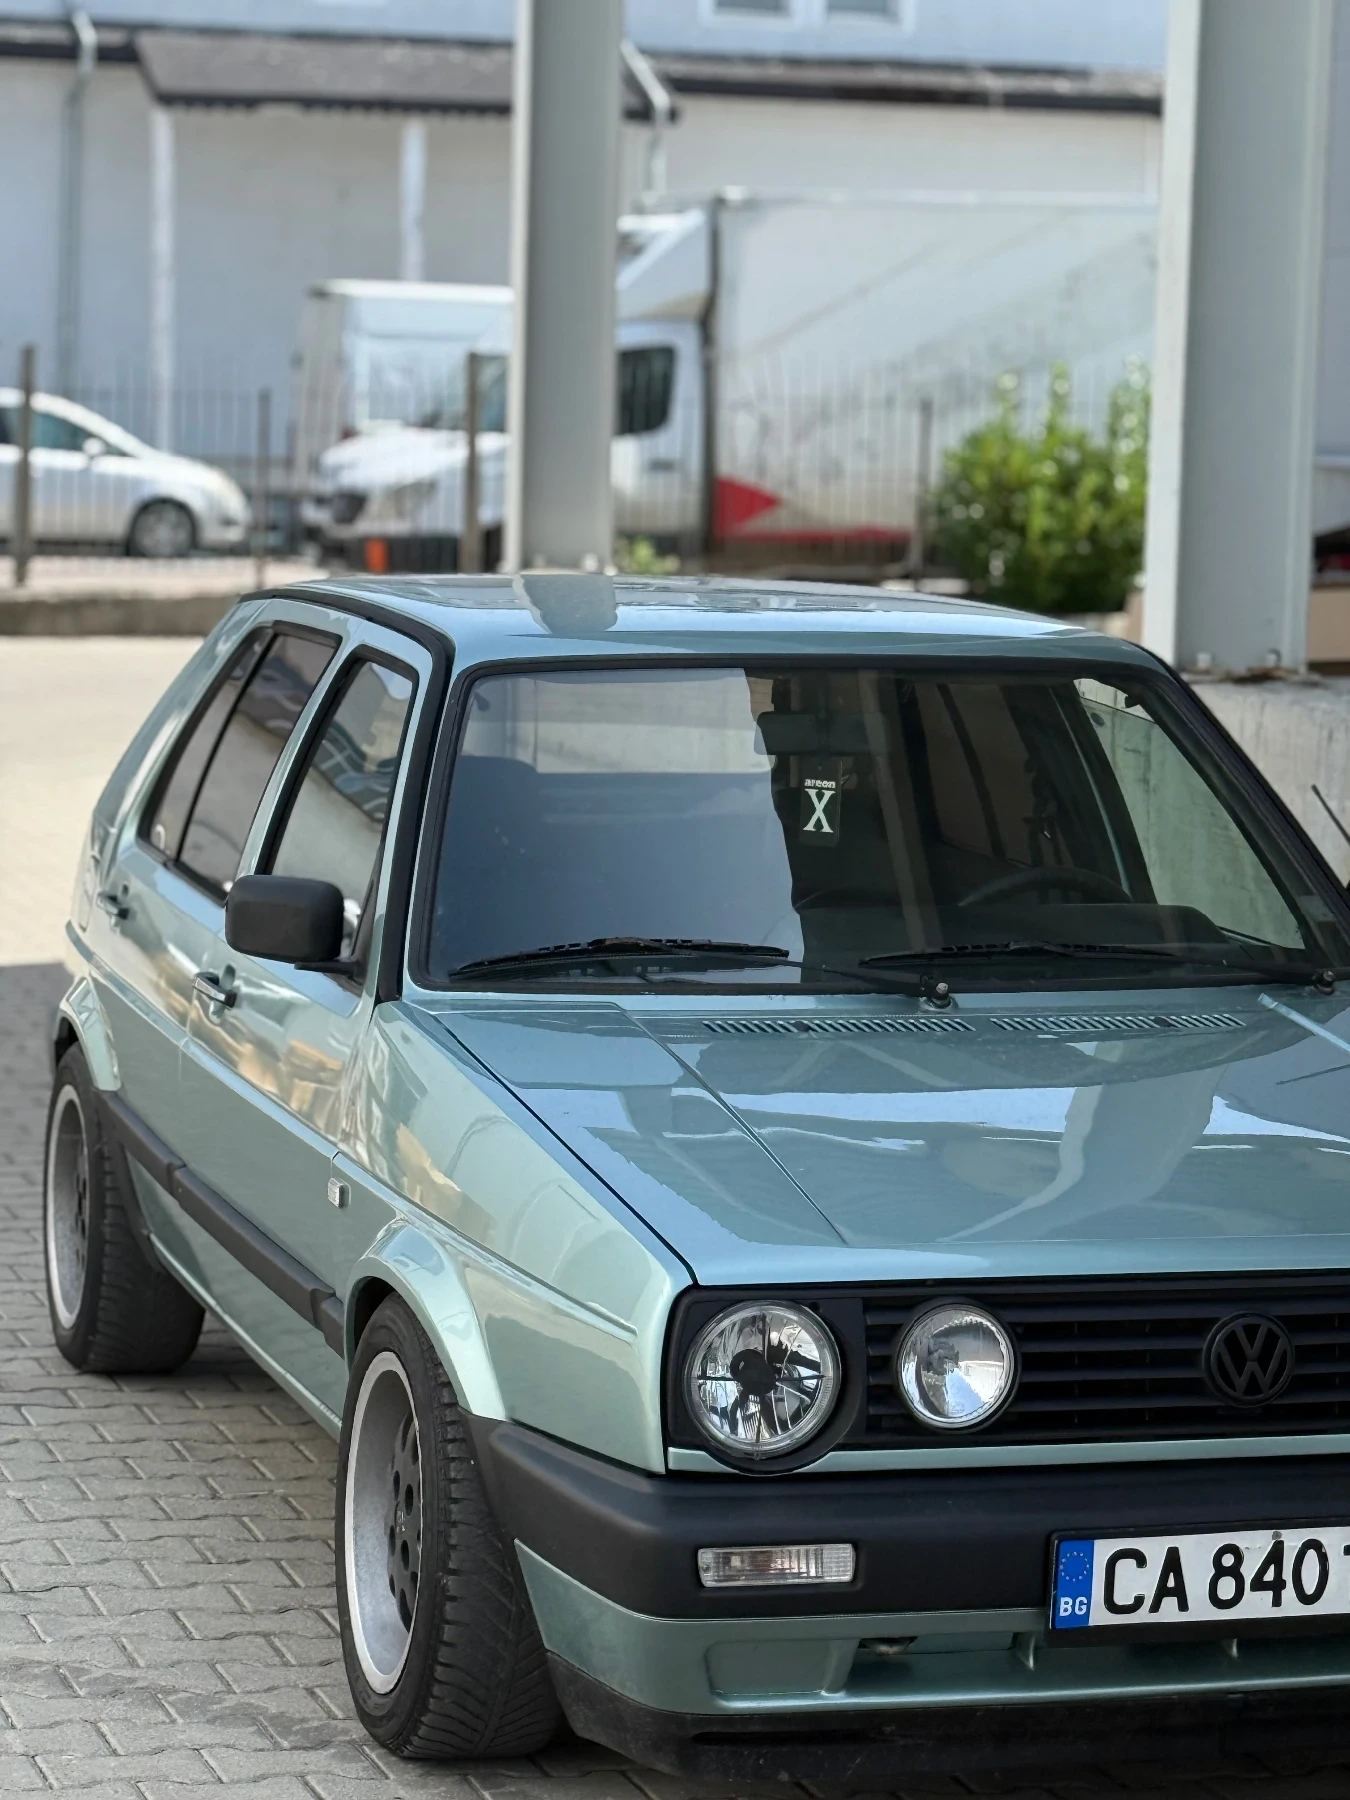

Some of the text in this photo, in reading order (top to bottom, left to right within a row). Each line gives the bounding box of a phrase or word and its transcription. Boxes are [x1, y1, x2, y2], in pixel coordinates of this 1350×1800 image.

[802, 788, 836, 833] X
[1211, 1319, 1290, 1399] VW
[1207, 1538, 1350, 1610] 840
[1059, 1596, 1088, 1617] BG
